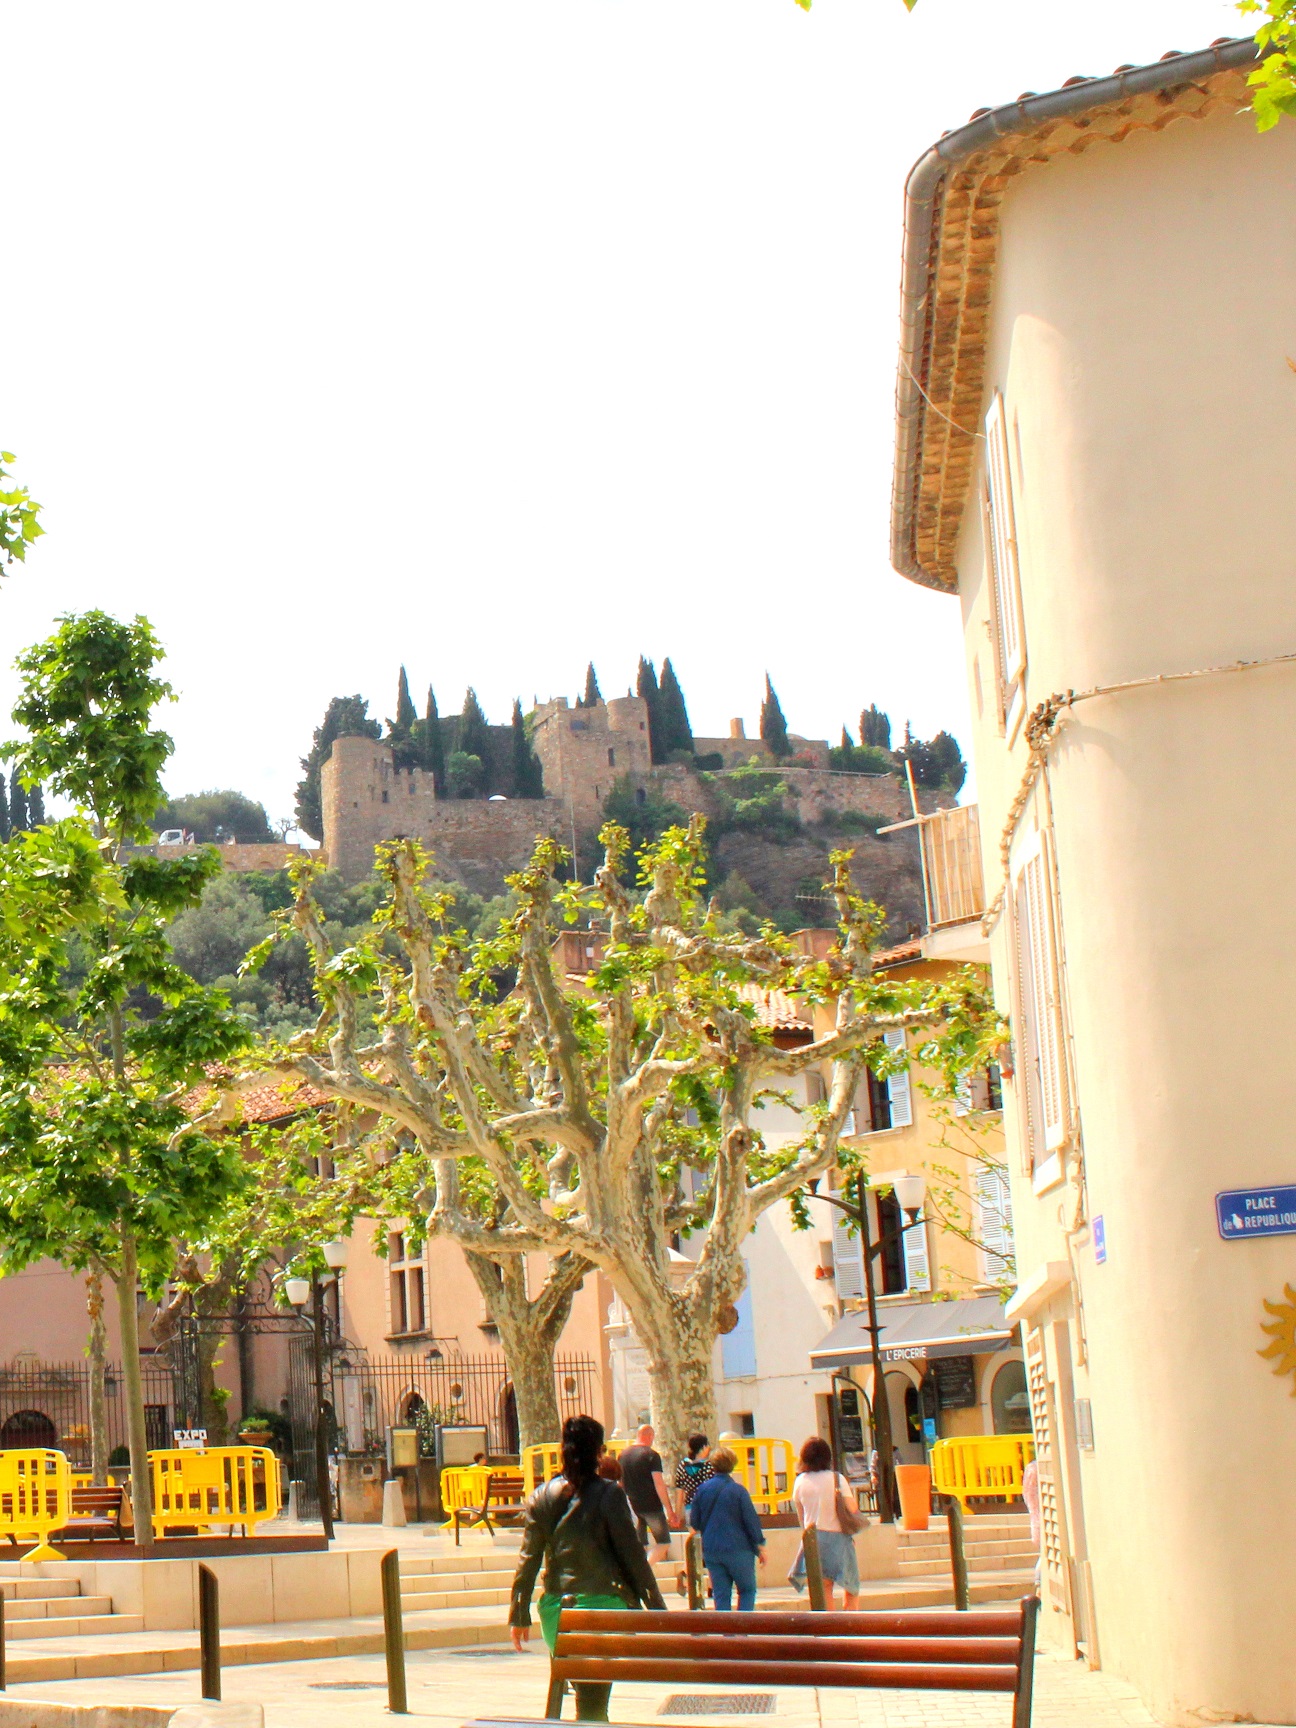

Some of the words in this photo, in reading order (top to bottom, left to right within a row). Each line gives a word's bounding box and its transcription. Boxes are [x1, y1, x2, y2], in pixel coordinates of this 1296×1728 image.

[1245, 1196, 1277, 1211] PLACE
[1244, 1212, 1296, 1228] REPUBLIQU
[173, 1429, 208, 1441] EXPO
